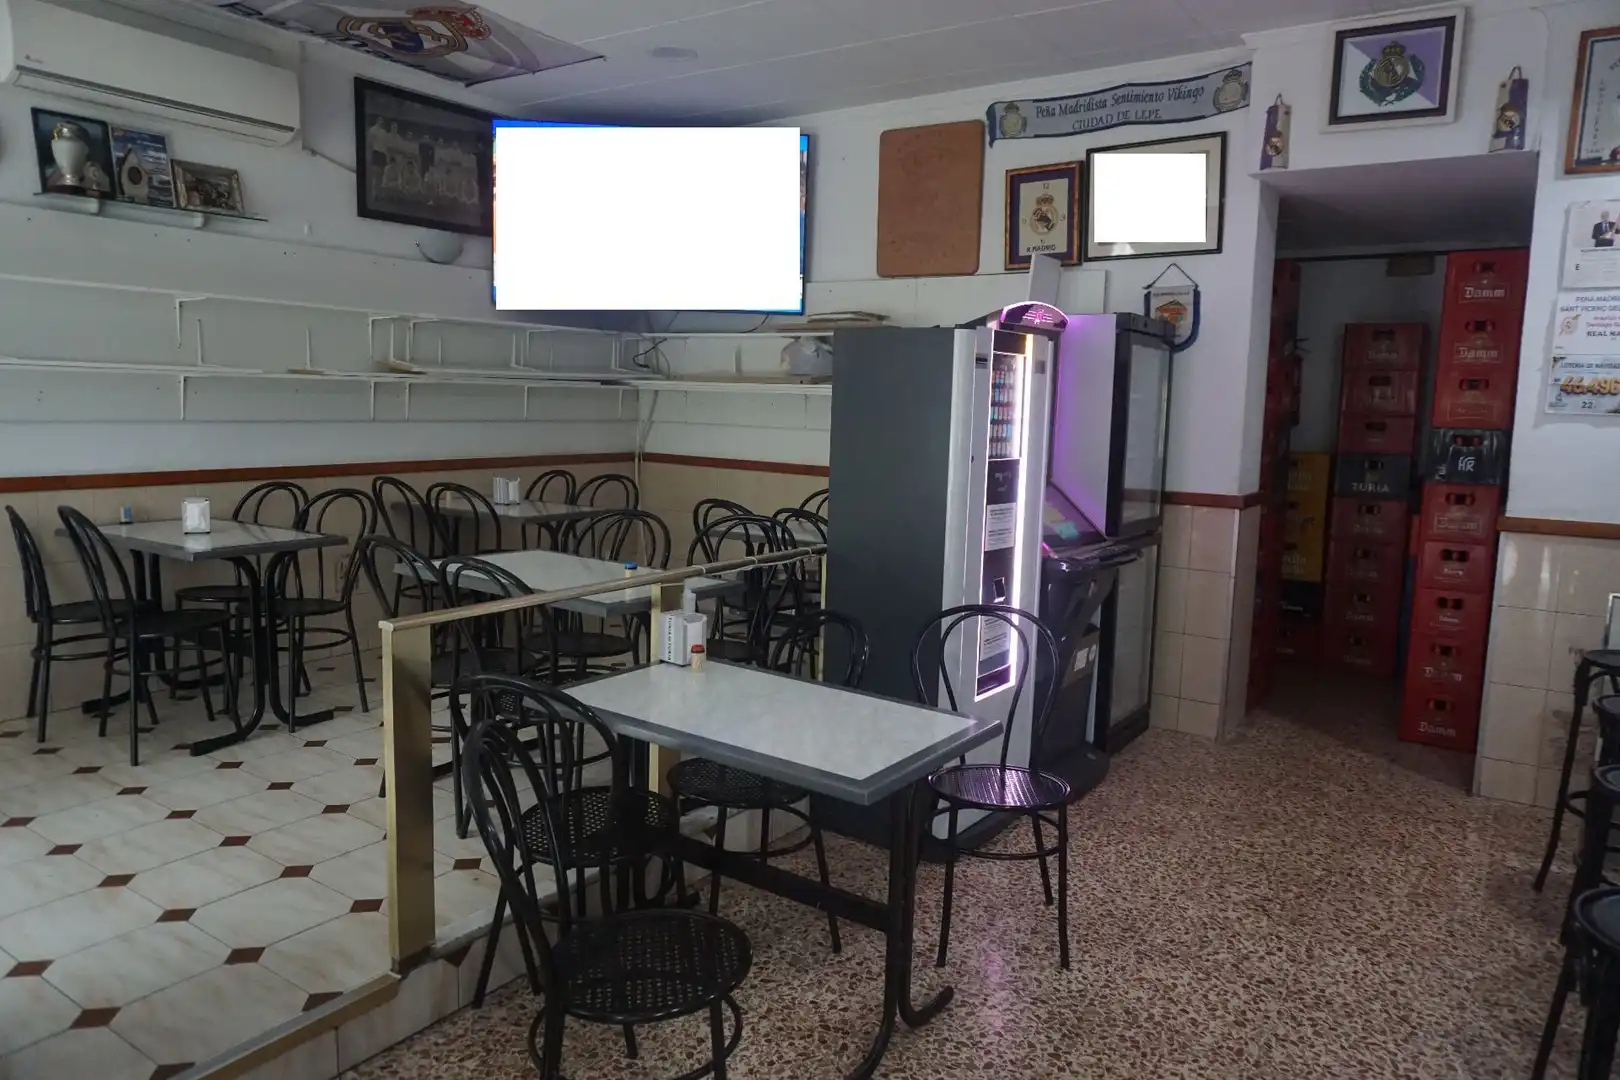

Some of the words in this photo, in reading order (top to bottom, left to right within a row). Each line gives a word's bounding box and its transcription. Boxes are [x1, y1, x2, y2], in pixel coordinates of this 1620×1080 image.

[1036, 105, 1056, 118] Peña
[1059, 97, 1107, 117] Madridista
[1111, 88, 1164, 107] Sentimiento
[1168, 84, 1205, 104] Vikingo
[1072, 113, 1114, 131] CIUDAD
[1117, 110, 1131, 121] DE
[1135, 108, 1162, 120] LEPE
[1464, 286, 1505, 298] Damm
[1458, 346, 1498, 358] Damm
[1352, 482, 1389, 493] TURIA
[1418, 721, 1456, 737] Damm
